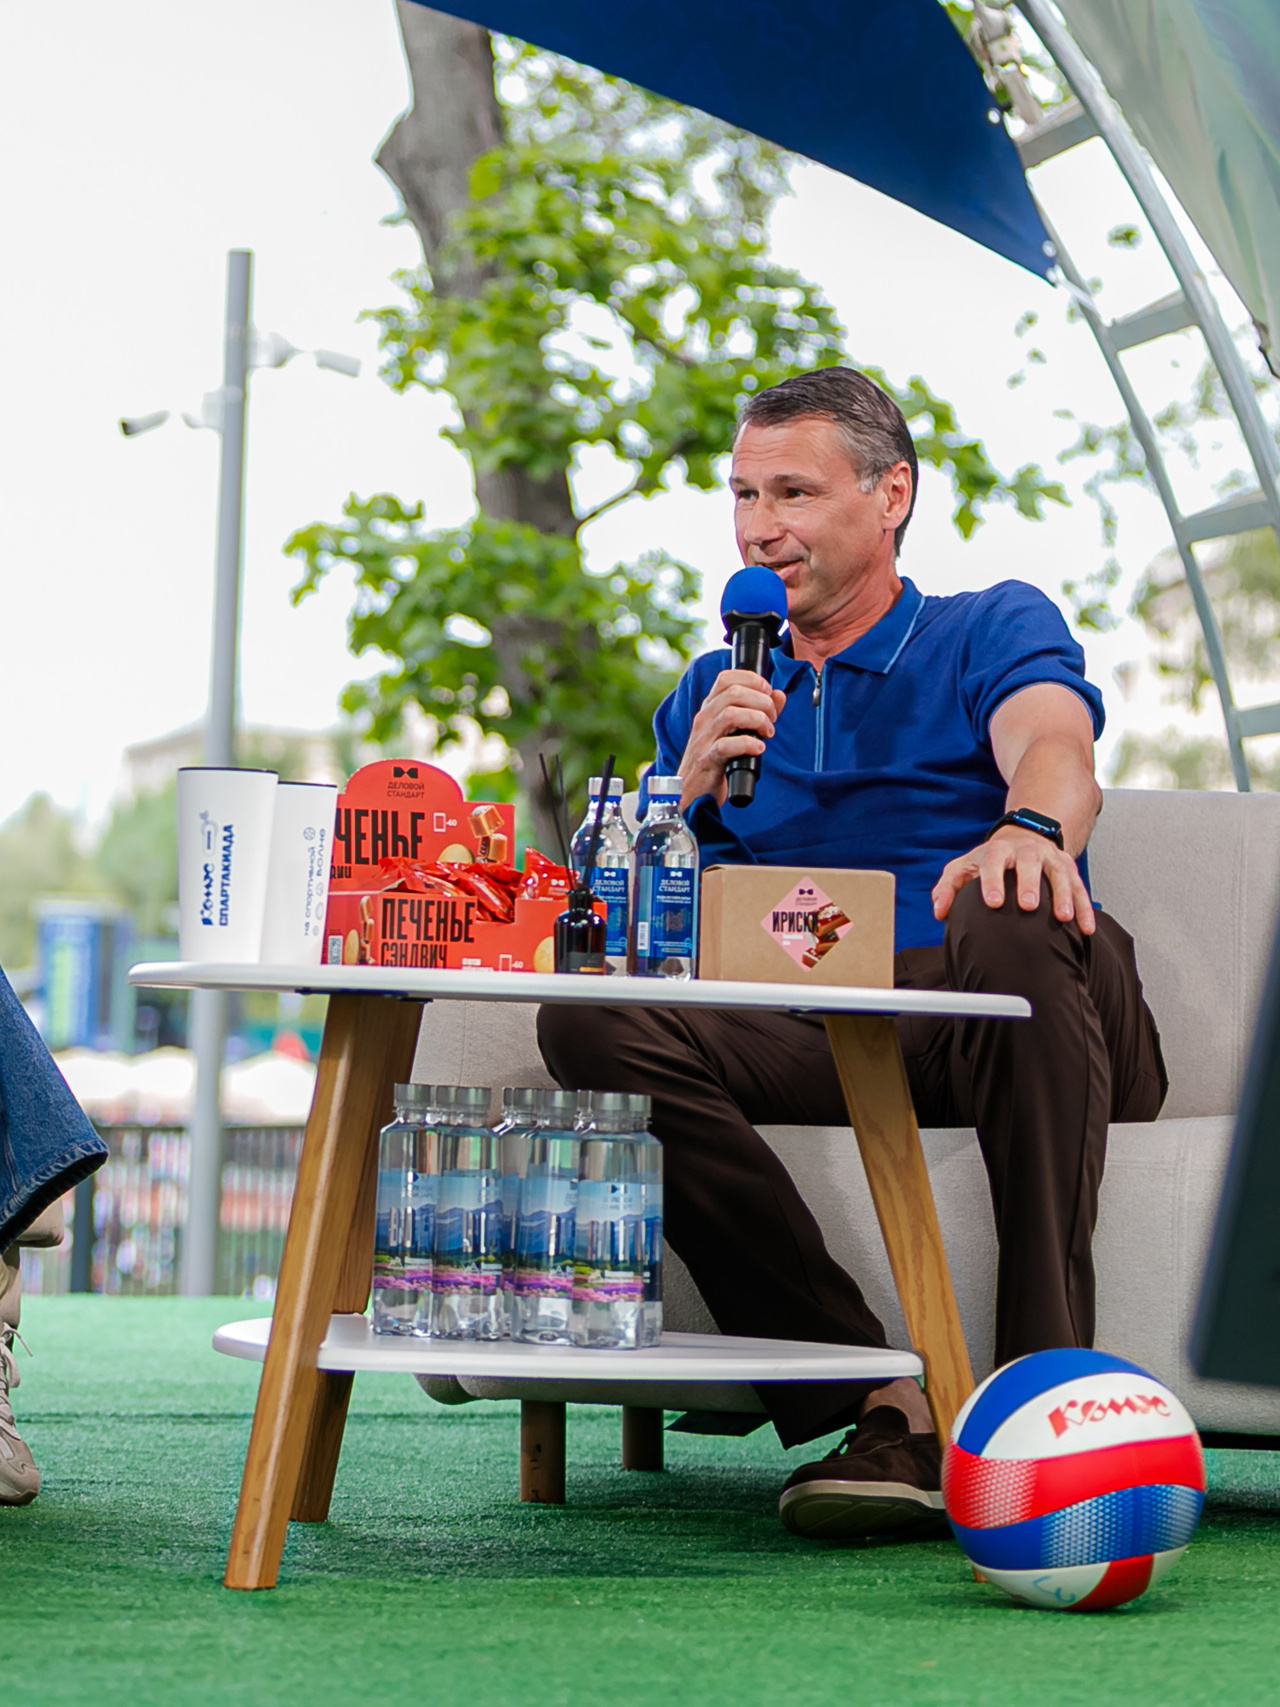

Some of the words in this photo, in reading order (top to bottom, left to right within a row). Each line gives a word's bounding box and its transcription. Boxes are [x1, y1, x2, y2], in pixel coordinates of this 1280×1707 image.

[387, 781, 425, 791] ДЕЛОВОЙ
[387, 790, 425, 799] СТАНДАРТ
[219, 823, 236, 927] СПАРТАКИАДА
[381, 897, 476, 943] ПЕЧЕНЬЕ
[772, 911, 820, 933] ИРИСКИ
[380, 941, 448, 969] СЭНДВИЧ
